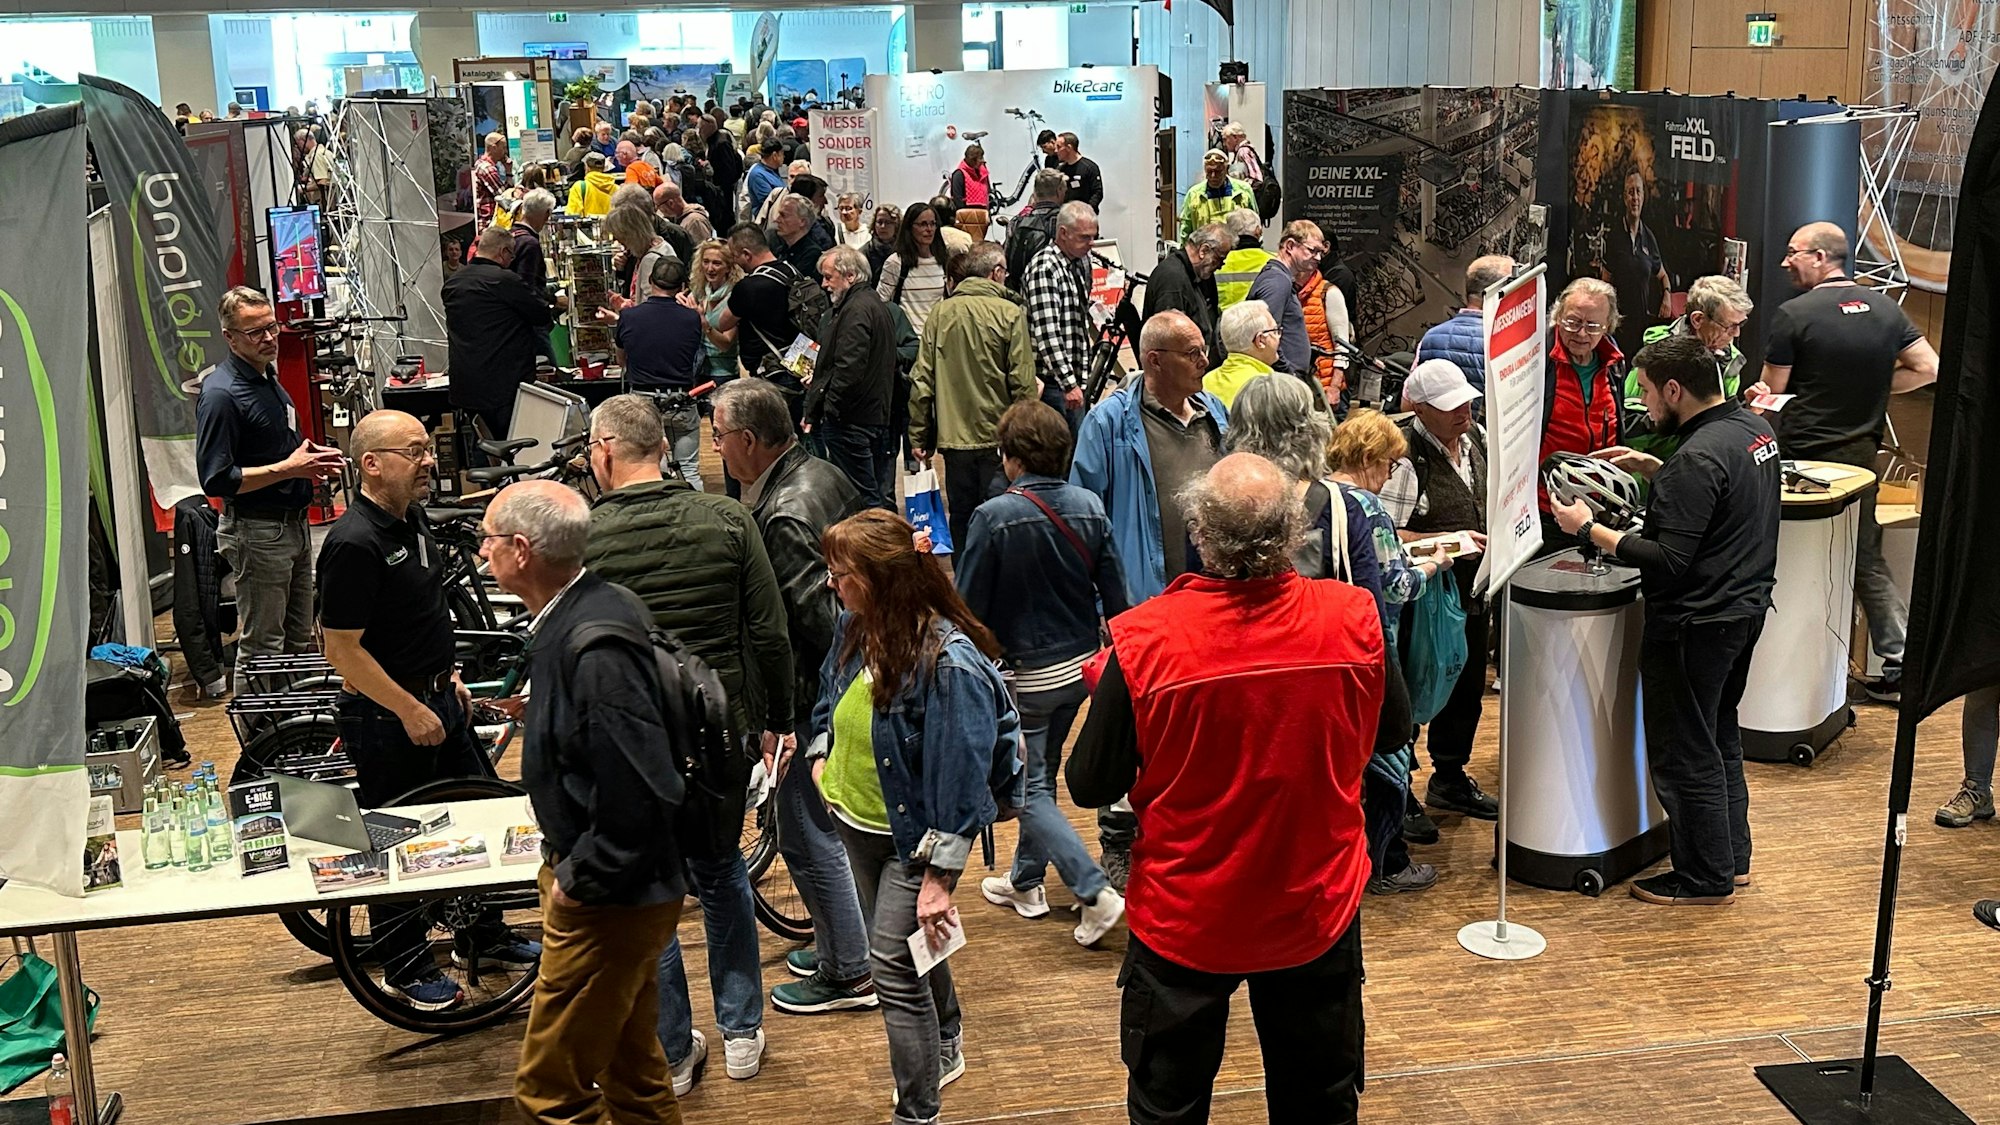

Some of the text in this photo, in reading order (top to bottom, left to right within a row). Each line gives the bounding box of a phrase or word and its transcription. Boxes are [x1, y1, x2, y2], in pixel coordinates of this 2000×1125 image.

[1053, 79, 1124, 93] bike2care
[900, 102, 946, 118] E-Faltrad
[822, 116, 865, 129] MESSE
[818, 137, 871, 149] SONDER
[1671, 134, 1716, 162] FELD
[827, 157, 865, 170] PREIS
[1308, 166, 1388, 180] DEINE XXL-
[1306, 185, 1375, 198] VORTEILE
[1753, 440, 1779, 466] FELD
[1514, 513, 1531, 542] FELD
[244, 791, 274, 804] E-BIKE
